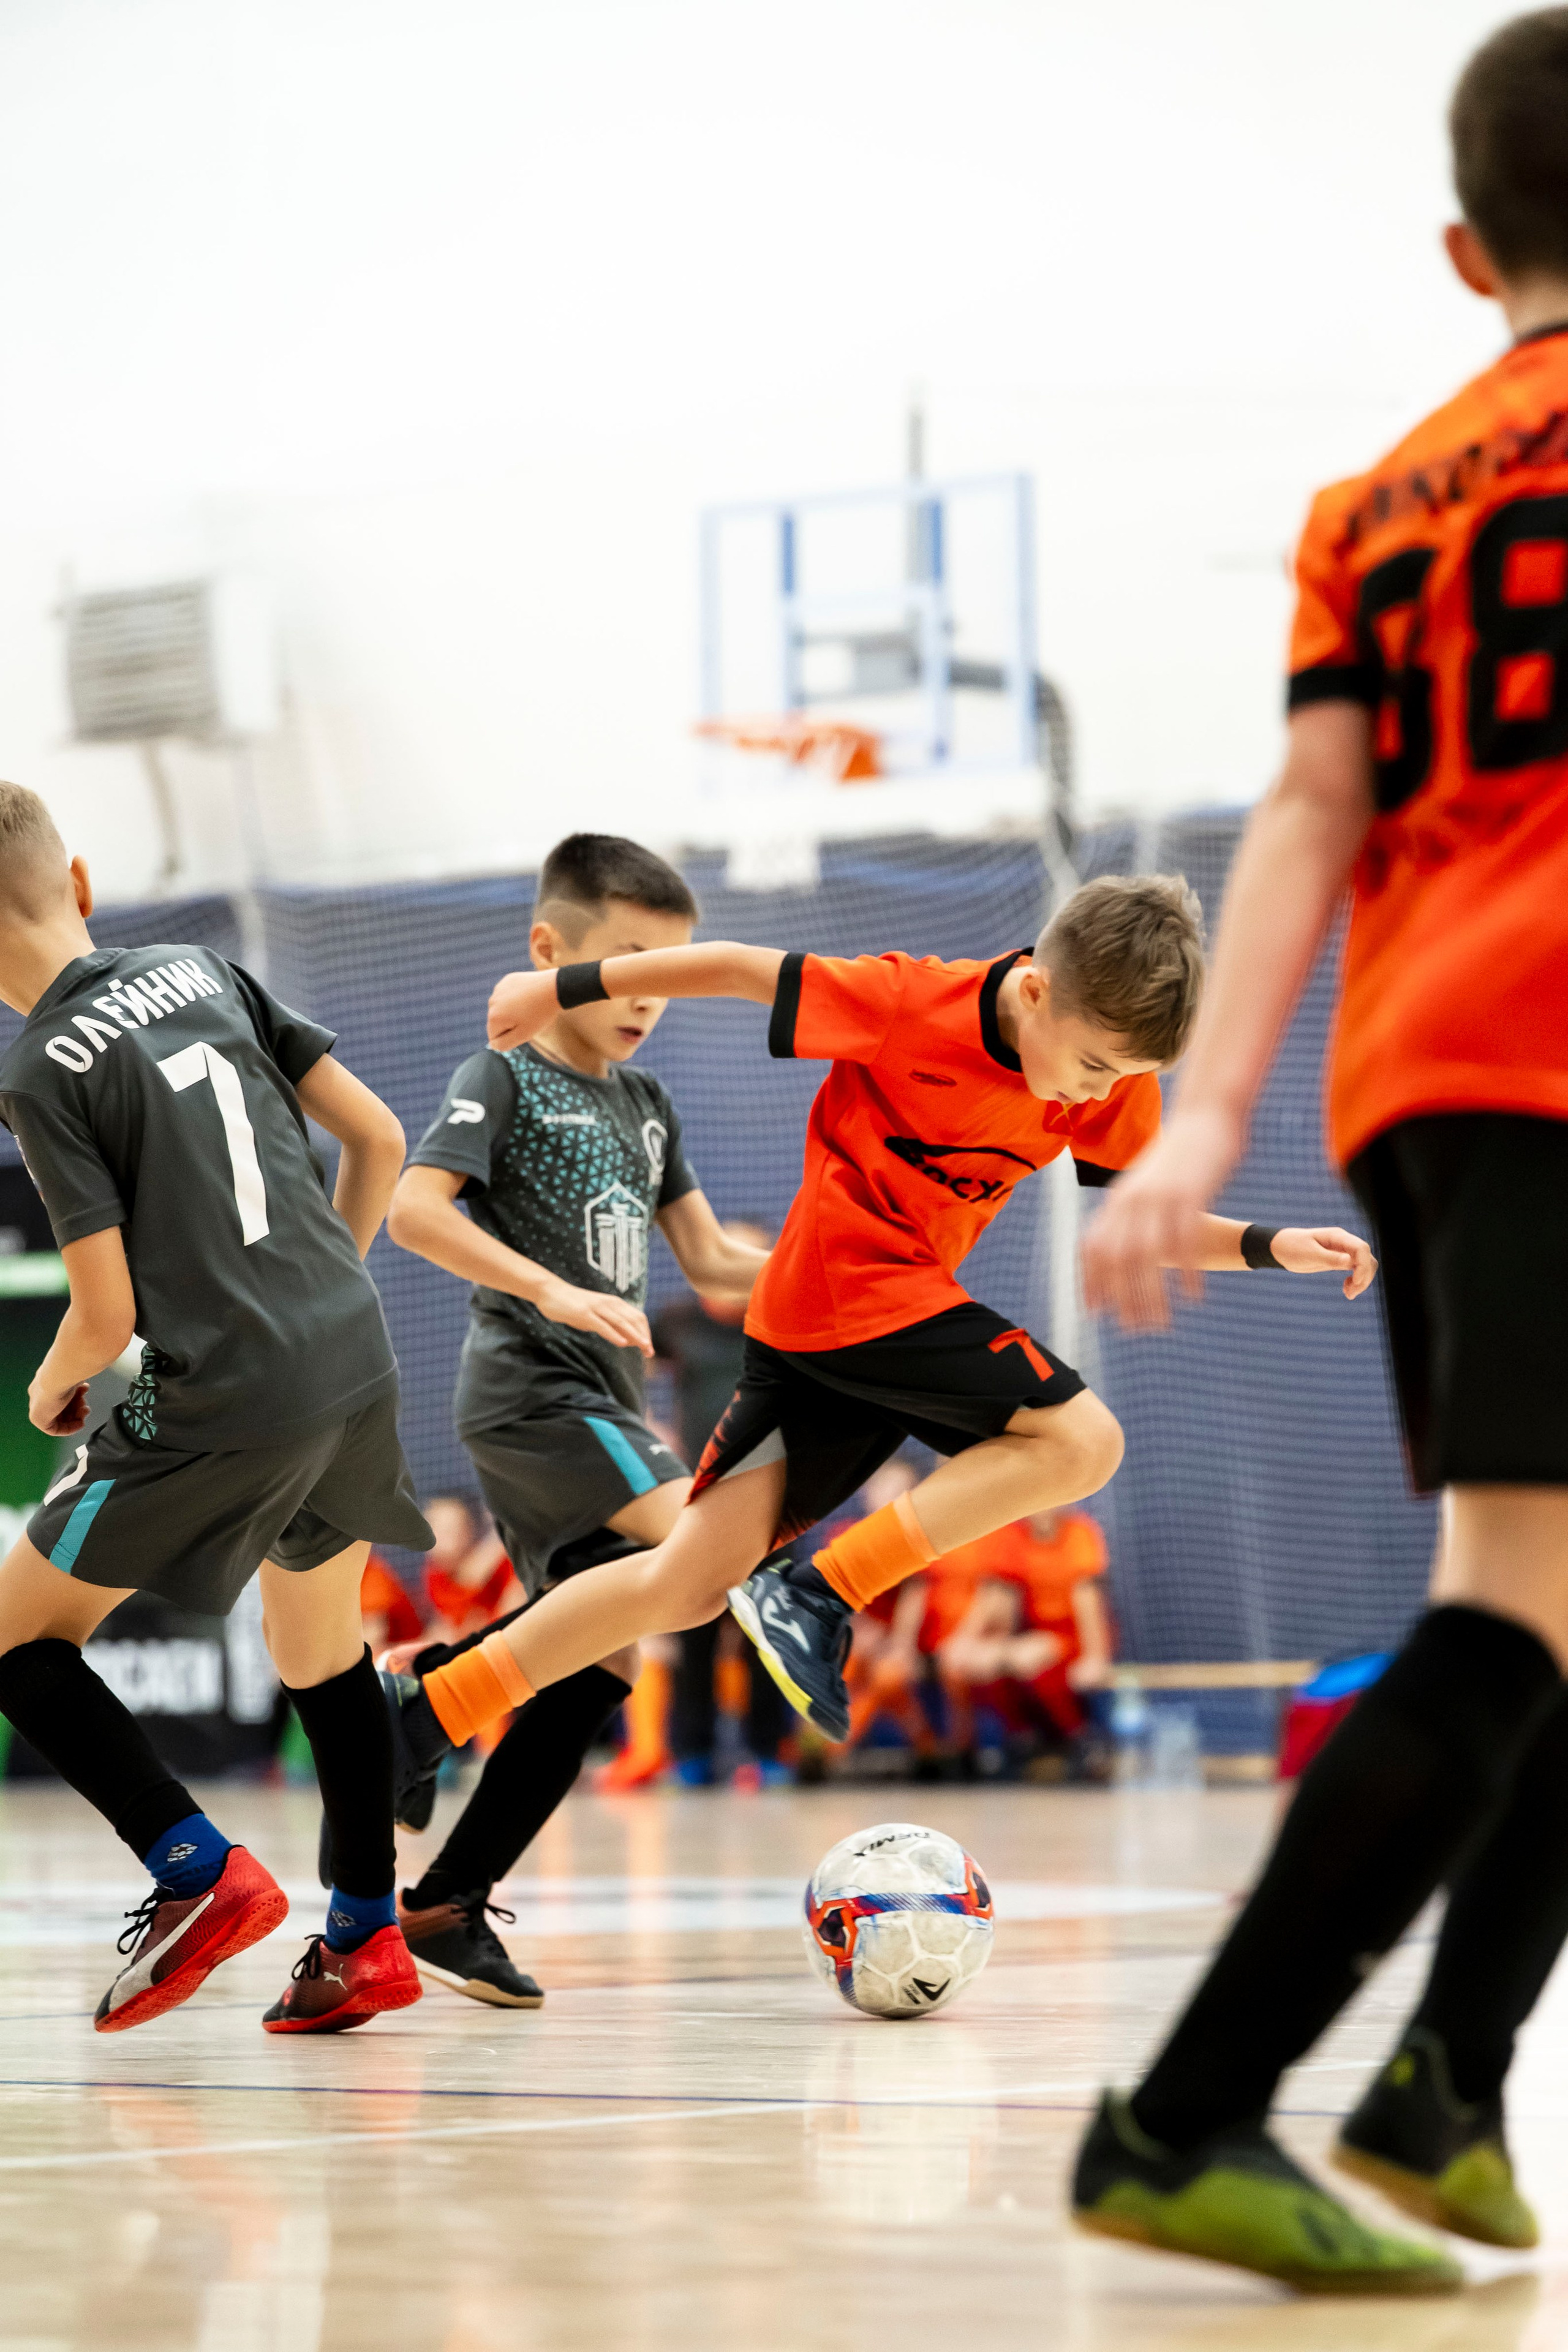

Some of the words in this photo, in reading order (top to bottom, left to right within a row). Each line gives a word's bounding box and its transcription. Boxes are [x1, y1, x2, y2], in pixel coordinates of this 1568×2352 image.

[45, 959, 223, 1072] ОЛЕЙНИК
[157, 1042, 270, 1246] 7
[987, 1328, 1054, 1381] 7
